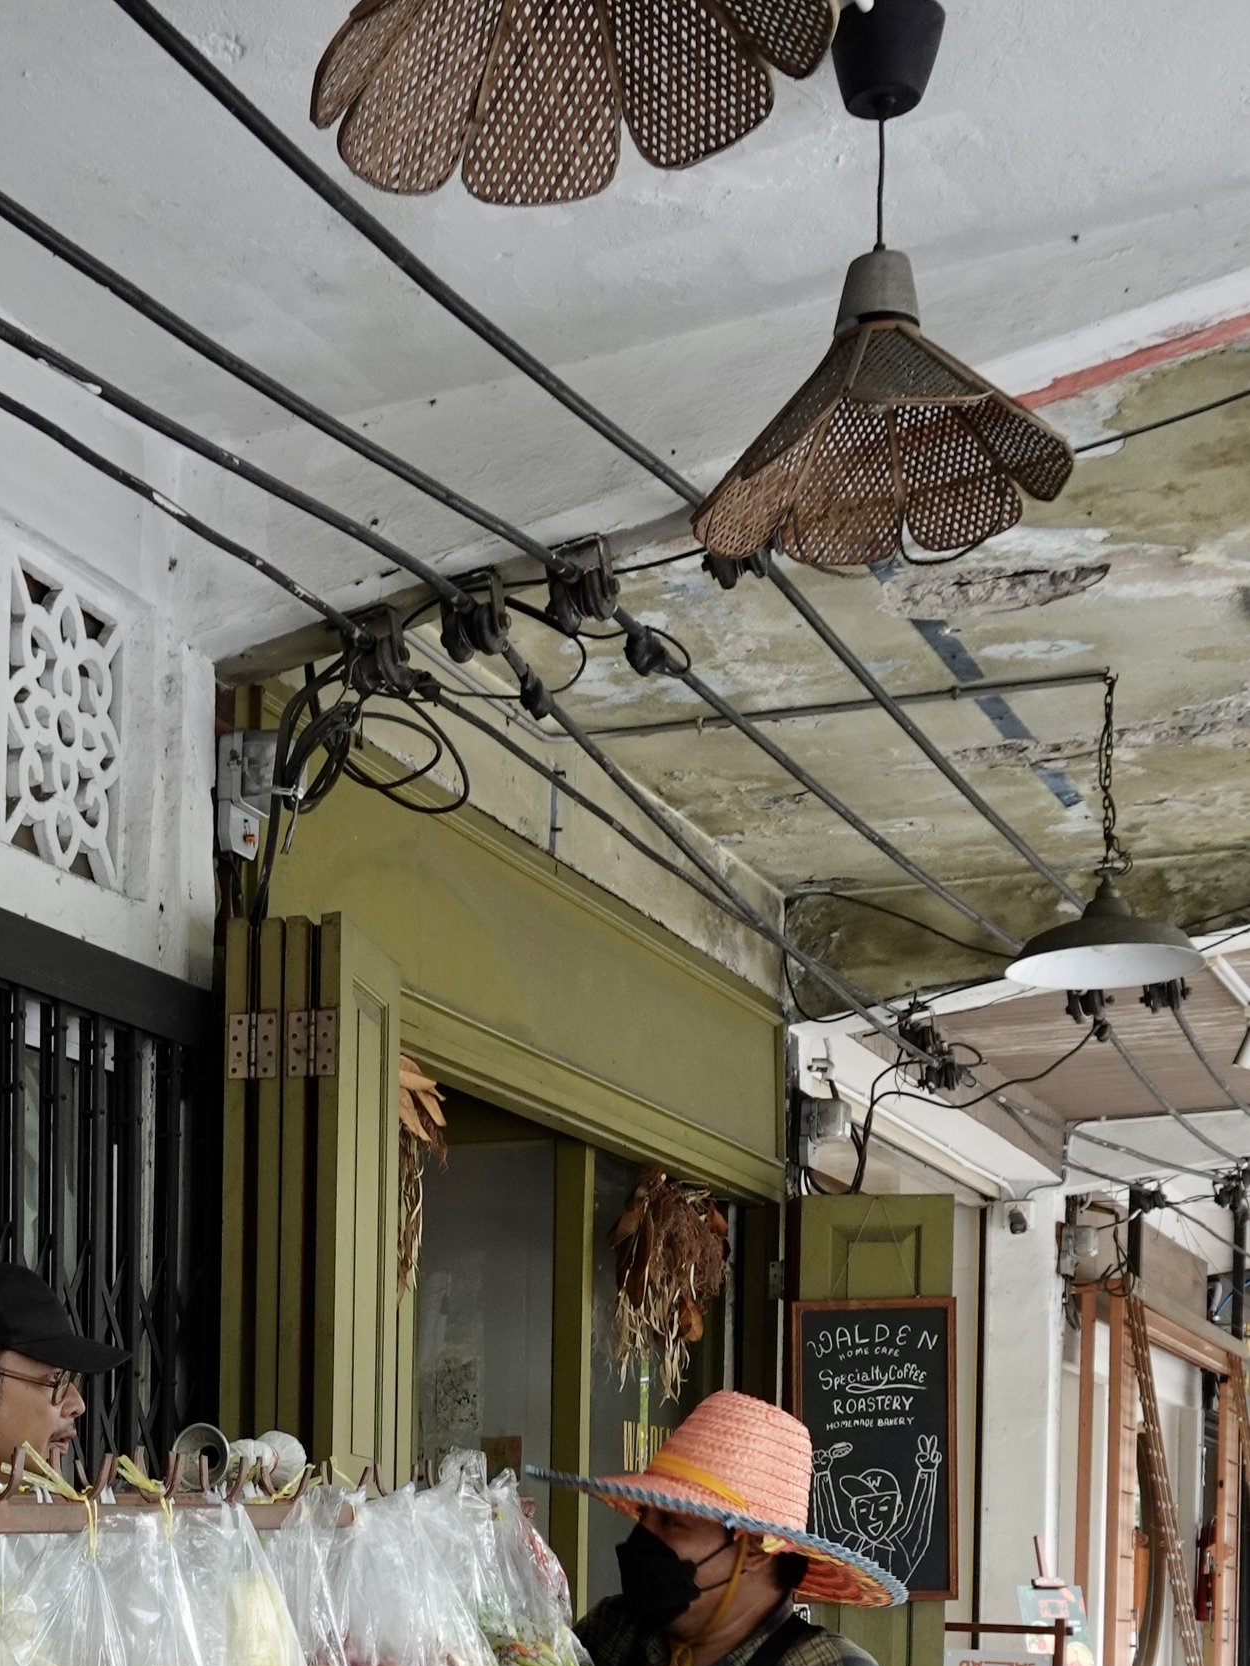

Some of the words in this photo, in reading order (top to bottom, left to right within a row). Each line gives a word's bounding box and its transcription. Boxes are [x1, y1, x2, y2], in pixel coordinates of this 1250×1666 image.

[806, 1323, 938, 1358] WALDEN
[838, 1346, 870, 1360] HOME
[874, 1346, 900, 1358] CAFE
[832, 1395, 914, 1415] ROASTERY
[825, 1418, 874, 1431] HOMEMADE
[876, 1416, 916, 1427] BAKERY
